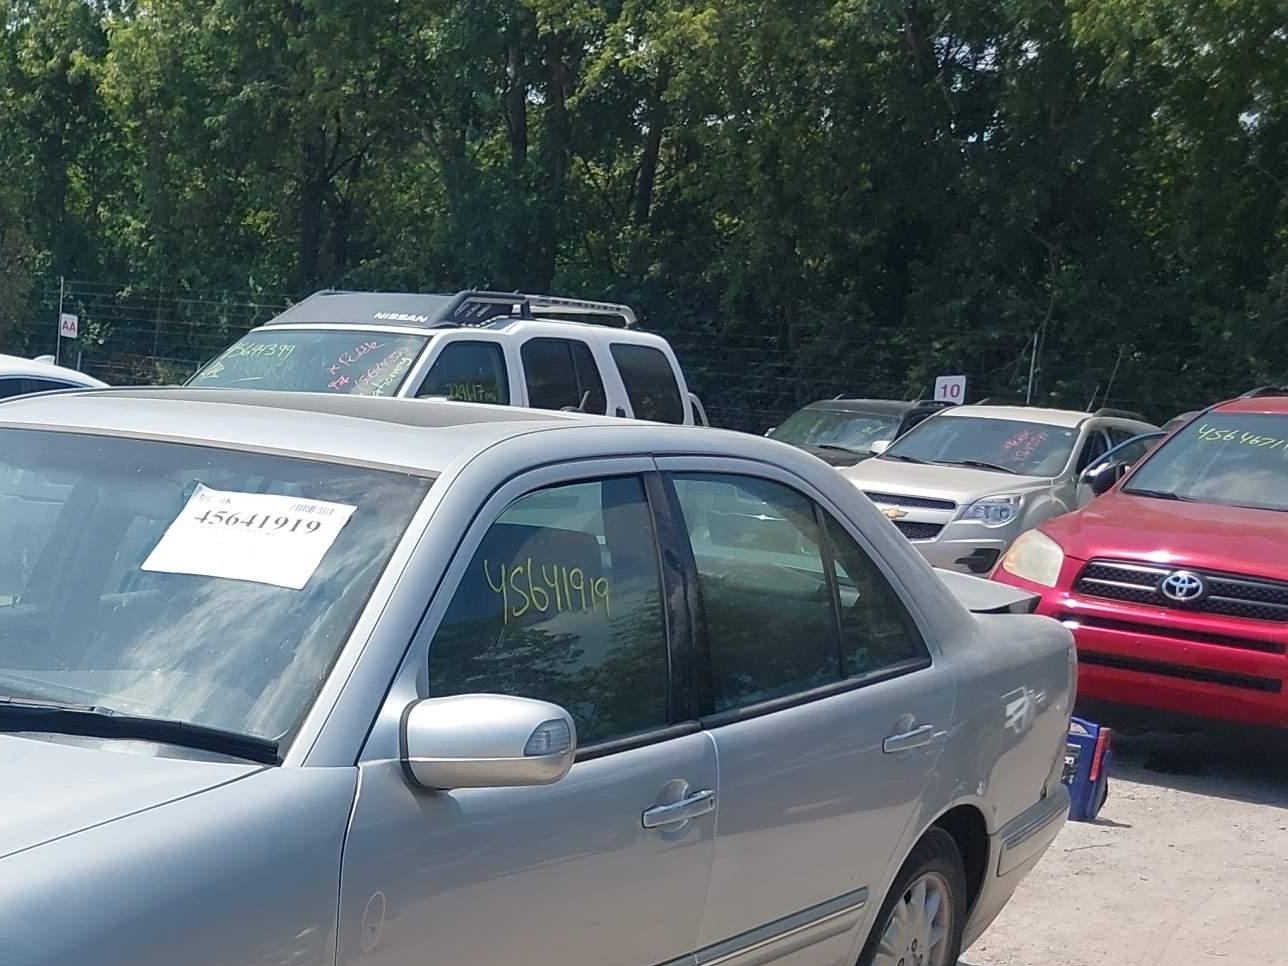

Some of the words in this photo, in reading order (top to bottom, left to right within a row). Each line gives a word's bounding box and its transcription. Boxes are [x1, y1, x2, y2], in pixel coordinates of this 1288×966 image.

[374, 311, 428, 323] NISSAN
[62, 319, 76, 333] AA
[940, 383, 961, 398] 10
[194, 509, 322, 534] 45641919
[484, 557, 611, 625] 45641919
